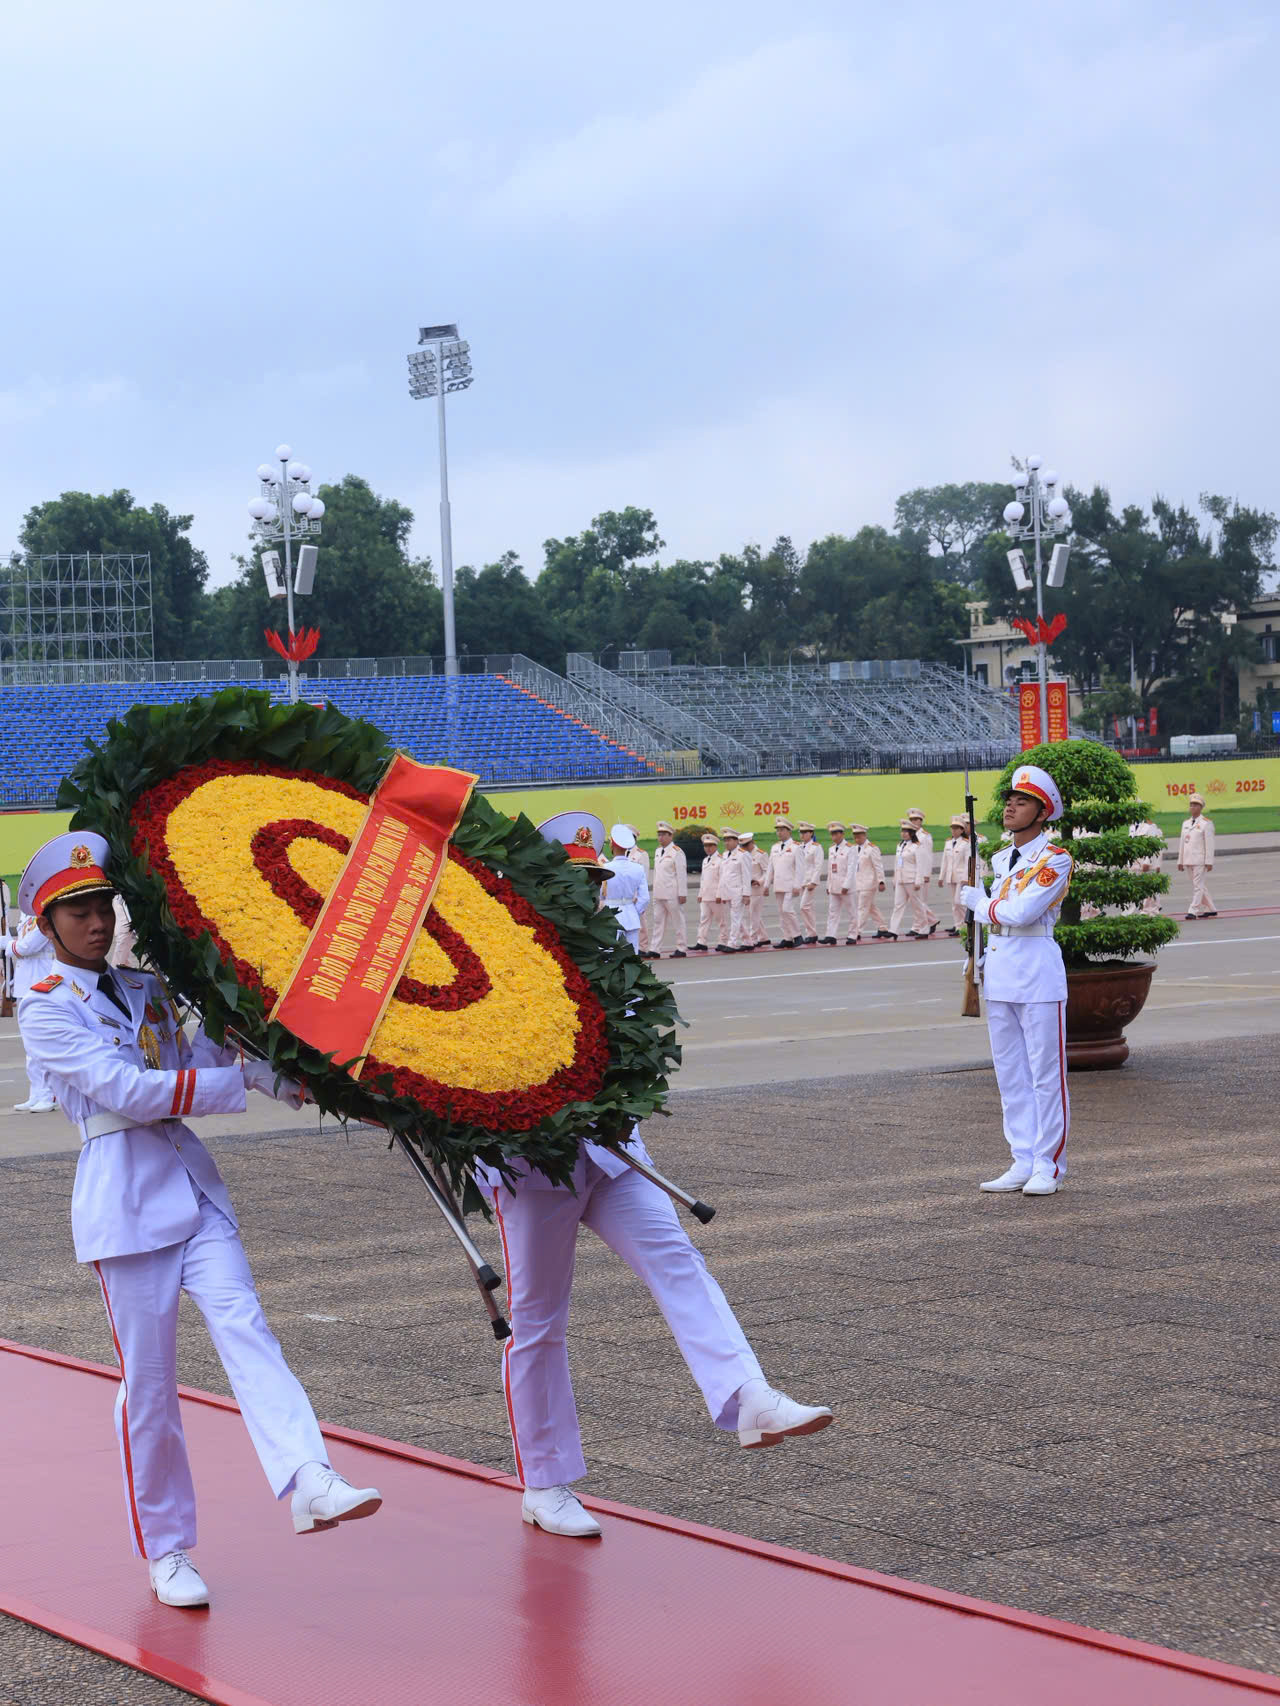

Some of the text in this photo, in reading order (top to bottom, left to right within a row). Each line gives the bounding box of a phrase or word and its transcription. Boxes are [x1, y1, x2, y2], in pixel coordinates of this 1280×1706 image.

[1166, 780, 1266, 797] 1945 2025
[673, 801, 790, 820] 1945 2025
[337, 895, 377, 924] CHỦ
[336, 919, 369, 940] ƠN
[324, 933, 360, 963] NHỚ
[374, 932, 404, 958] CÔNG
[304, 974, 343, 1002] ĐỜI
